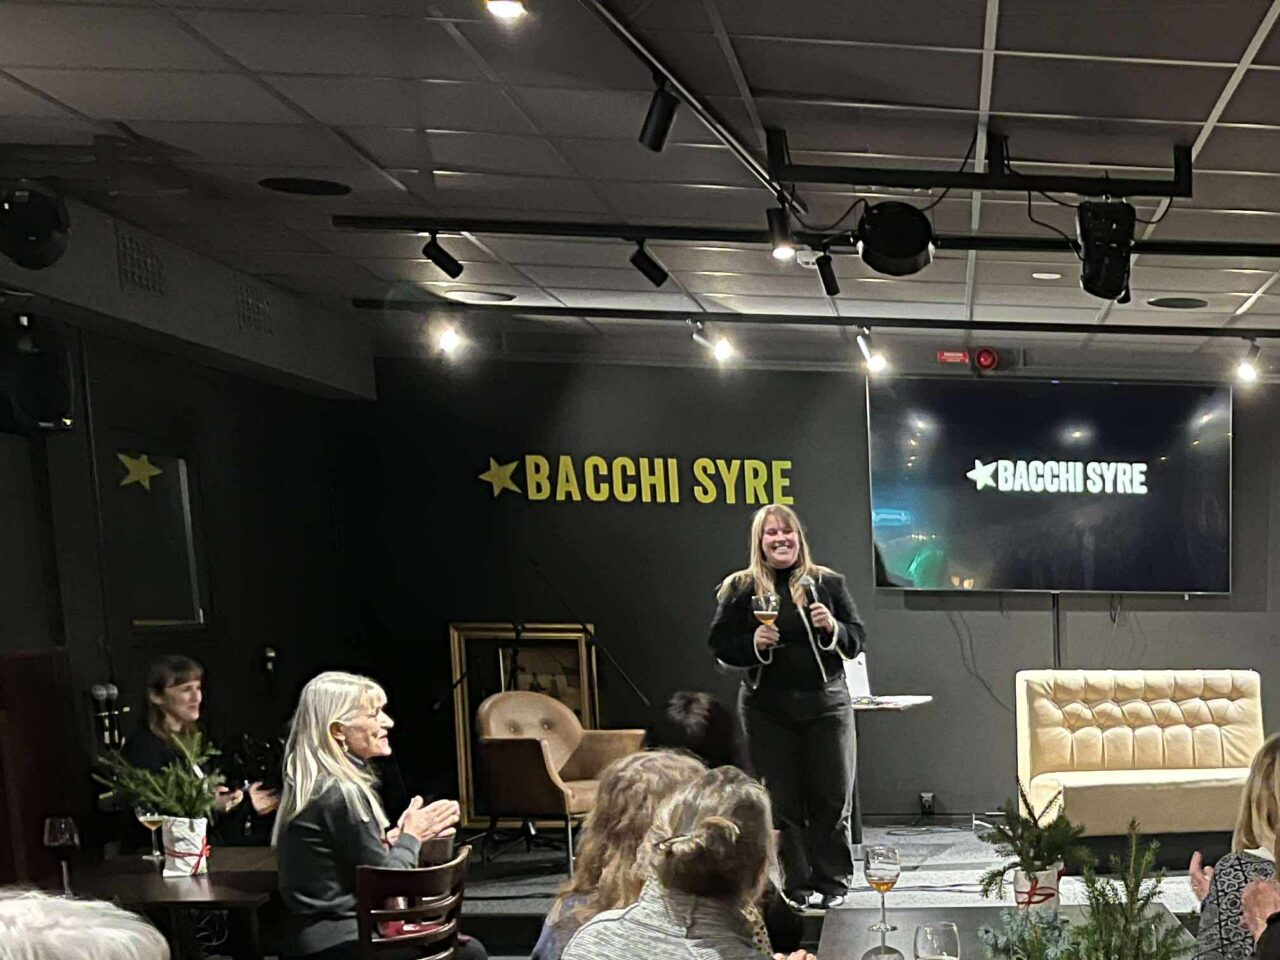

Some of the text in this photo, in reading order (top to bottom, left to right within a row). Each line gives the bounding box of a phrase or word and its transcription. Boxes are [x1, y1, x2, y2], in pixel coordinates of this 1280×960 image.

[525, 455, 794, 505] BACCHI SYRE
[998, 459, 1148, 494] BACCHI SYRE
